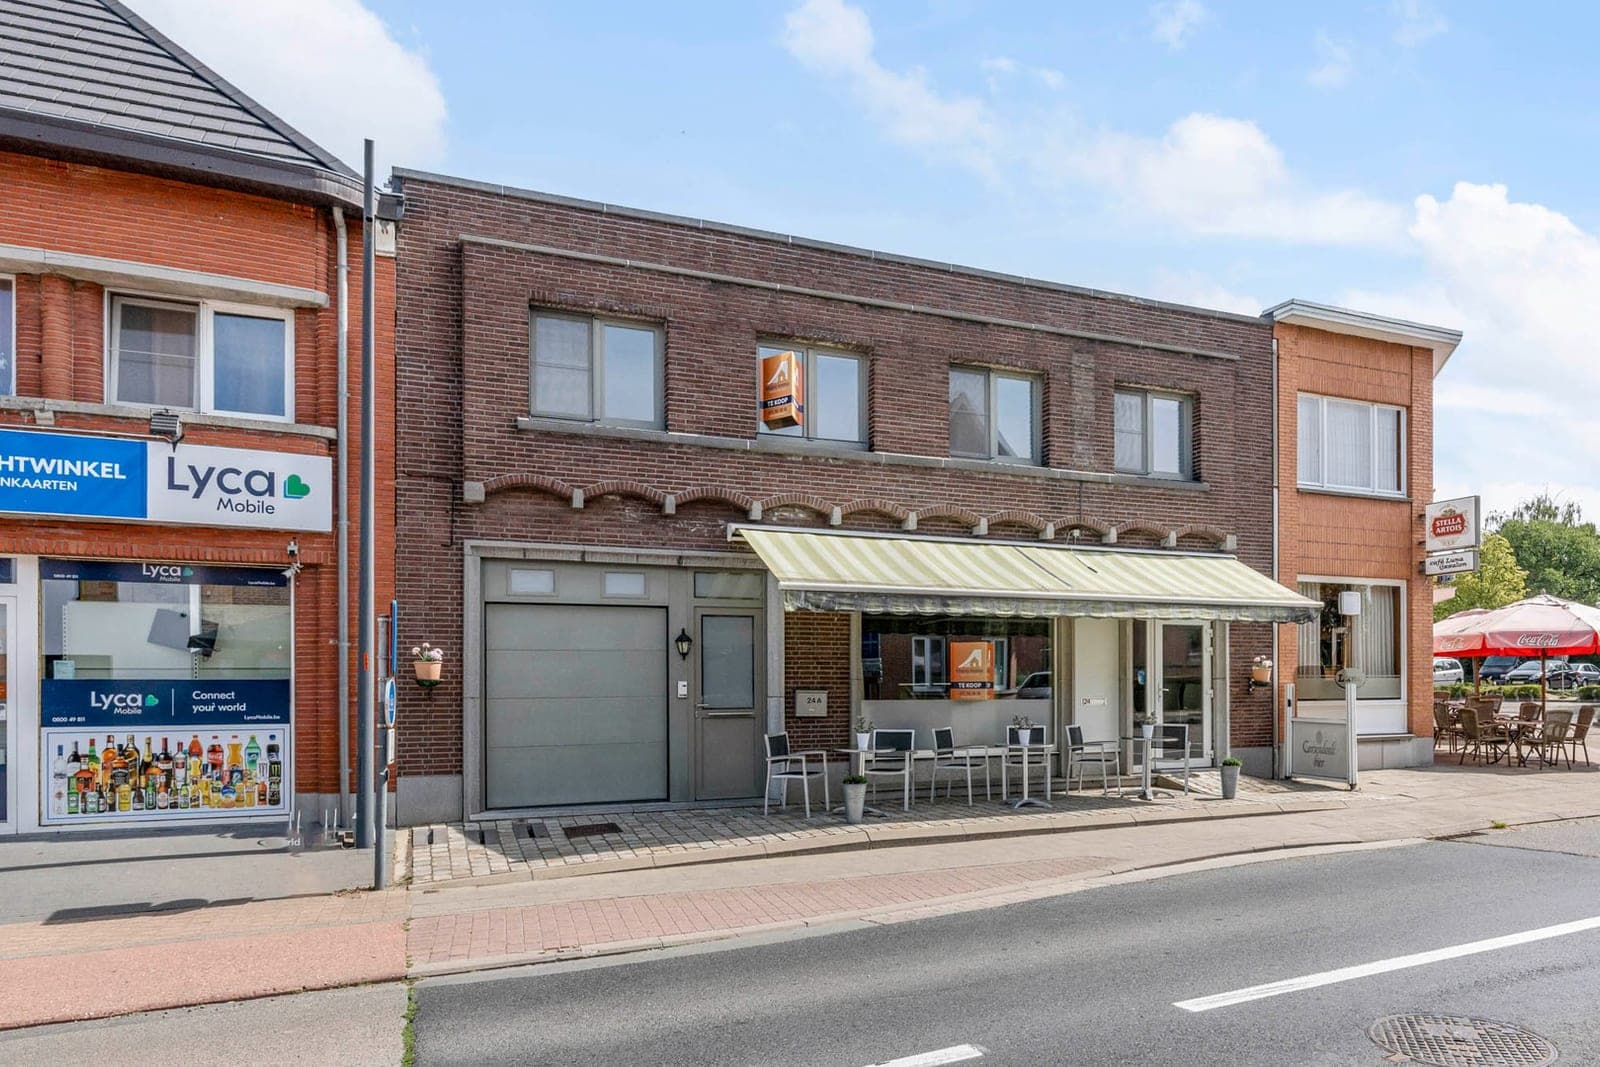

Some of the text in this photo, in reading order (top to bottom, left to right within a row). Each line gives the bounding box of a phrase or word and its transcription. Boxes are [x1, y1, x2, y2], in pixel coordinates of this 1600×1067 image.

[774, 397, 789, 405] KOOP
[0, 454, 127, 479] HTWINKEL
[167, 456, 276, 499] Lyca
[216, 497, 275, 515] Mobile
[1435, 517, 1462, 527] STELLA
[1435, 524, 1463, 534] ARTOIS
[142, 563, 182, 577] Lyca
[1517, 633, 1559, 647] Coca-Cola
[90, 691, 142, 710] Lyca
[192, 690, 235, 700] Connect
[113, 707, 142, 715] Mobile
[192, 702, 247, 714] your world
